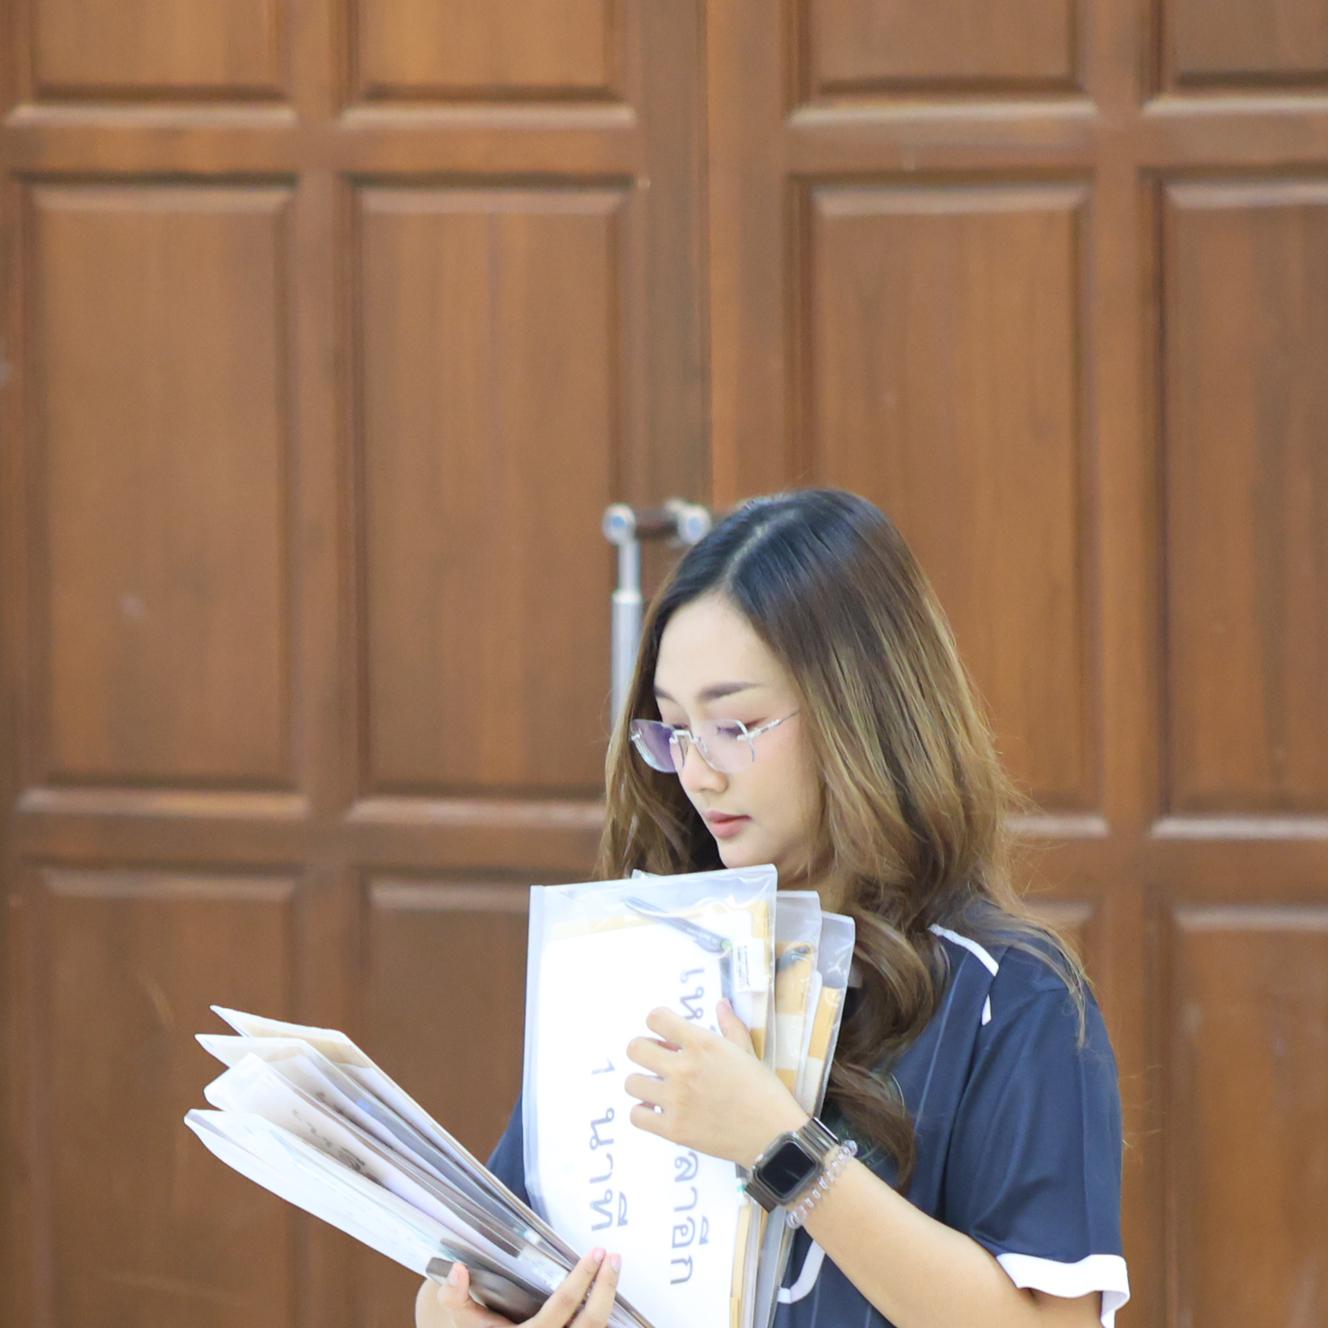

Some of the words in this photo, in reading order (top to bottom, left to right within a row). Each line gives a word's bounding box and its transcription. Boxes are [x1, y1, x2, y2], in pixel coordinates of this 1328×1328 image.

[589, 1057, 616, 1076] 1
[671, 967, 717, 1286] เหลาอีก
[589, 1107, 629, 1232] นาที
